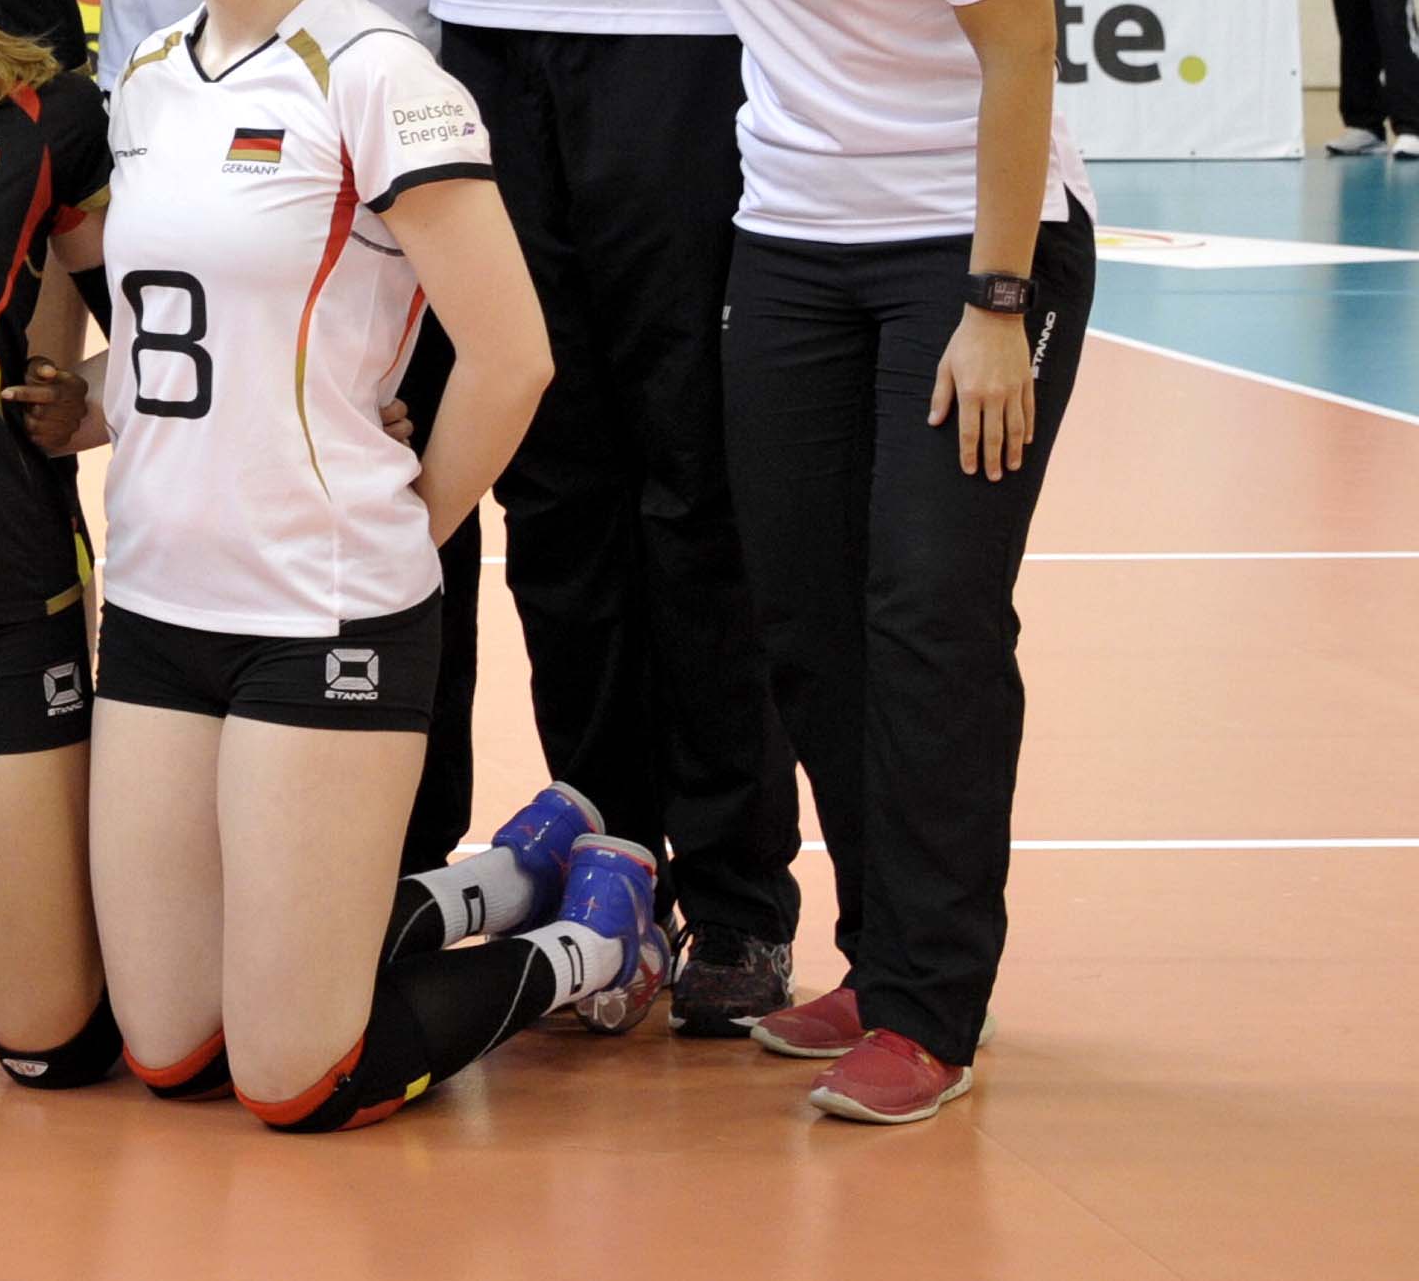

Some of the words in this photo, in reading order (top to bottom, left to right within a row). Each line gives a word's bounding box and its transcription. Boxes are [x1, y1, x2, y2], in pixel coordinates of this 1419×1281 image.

[393, 102, 464, 126] Deutsche
[399, 121, 460, 147] Energie
[221, 163, 280, 176] GERMANY
[121, 270, 214, 421] 8
[325, 689, 379, 701] STANNO
